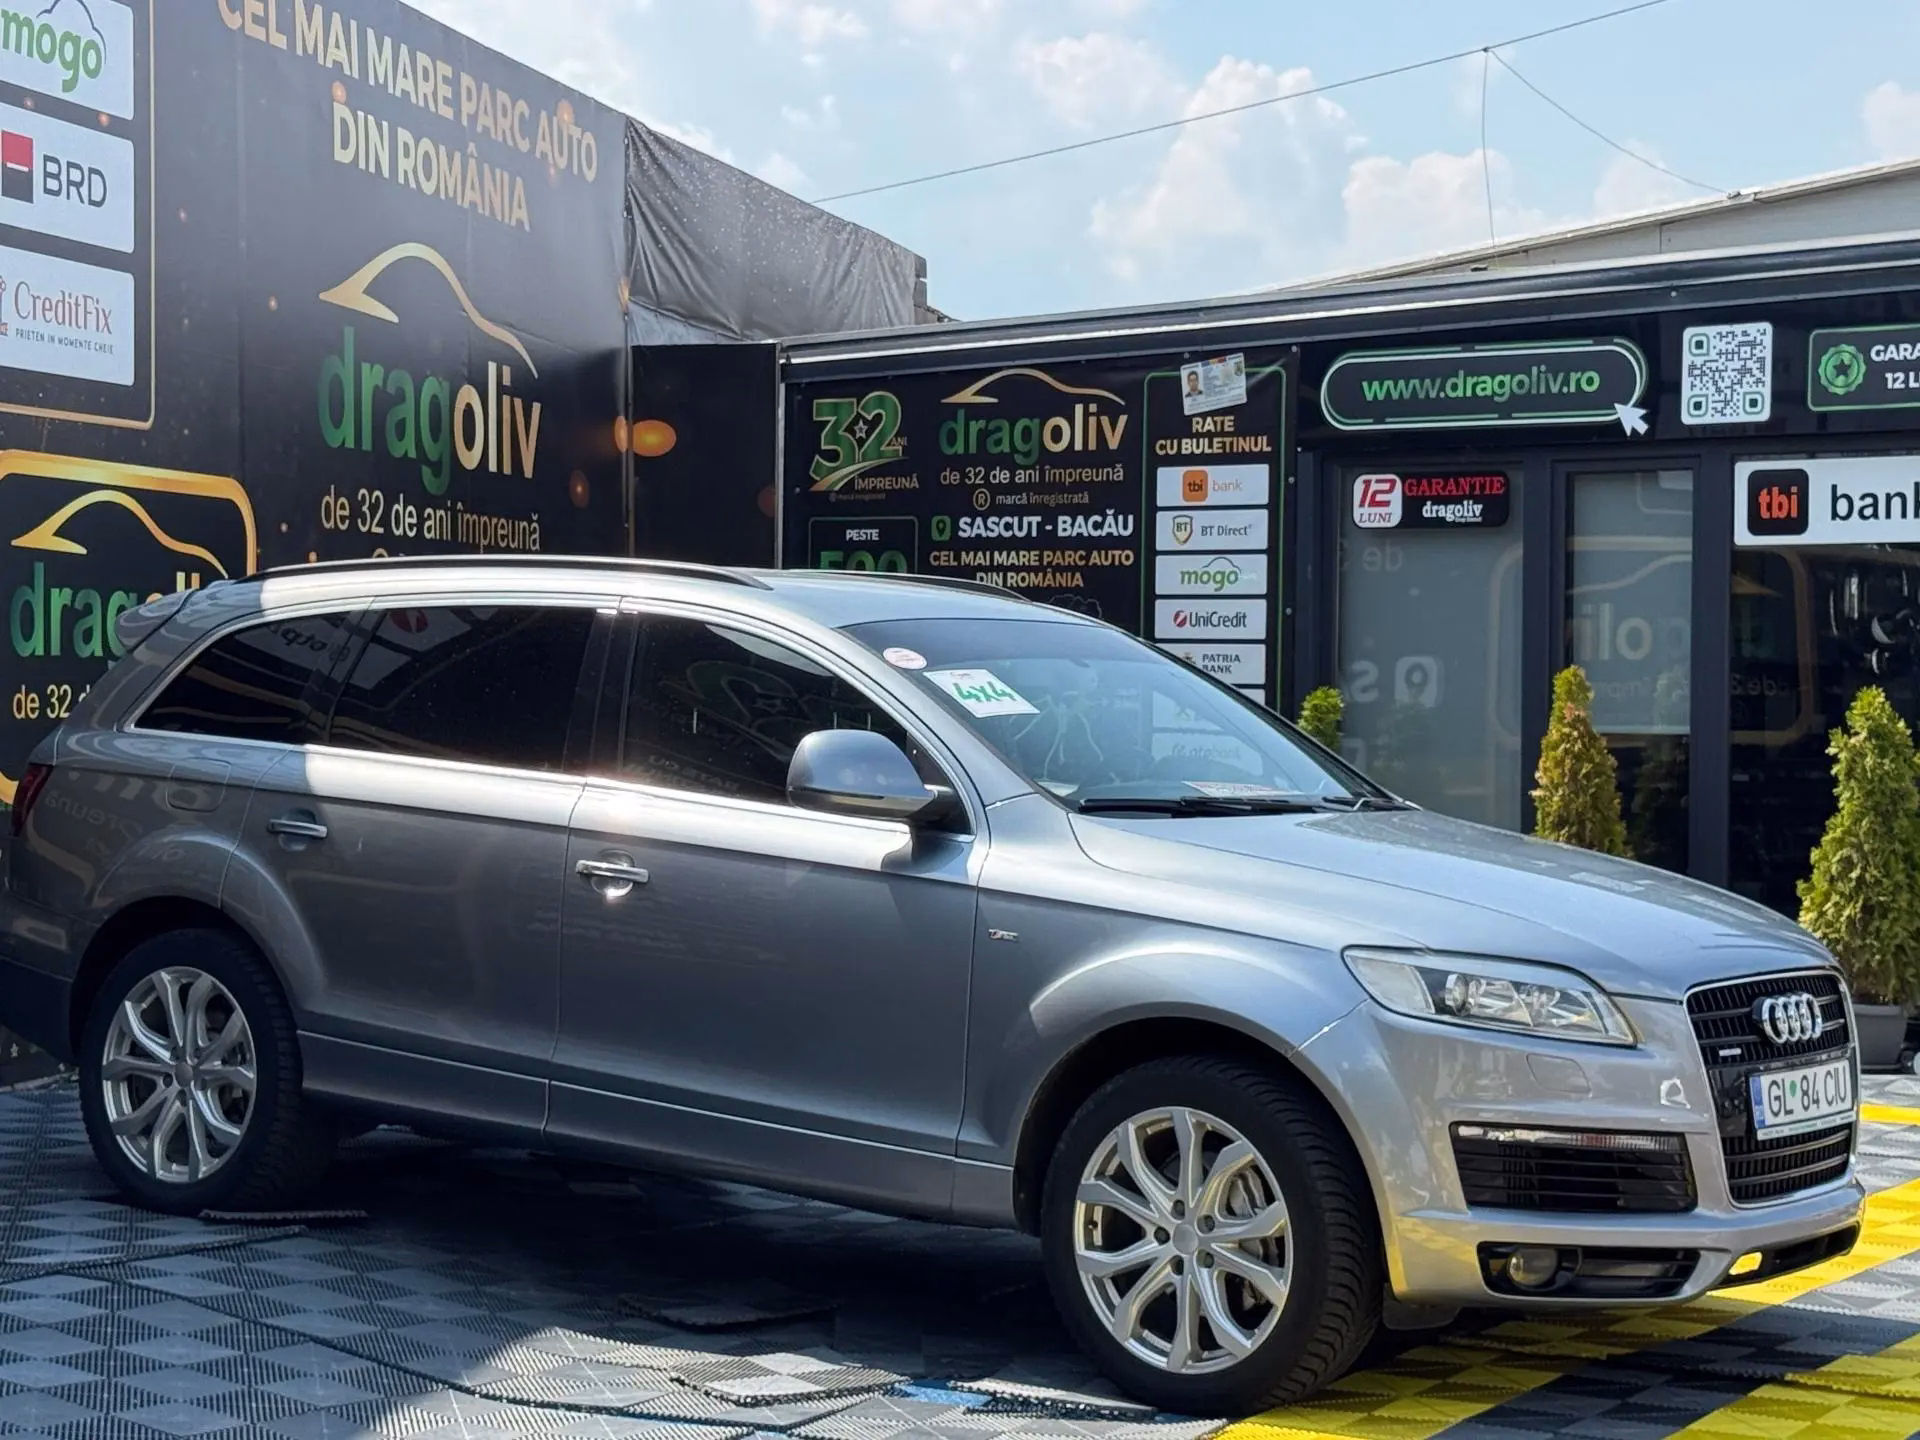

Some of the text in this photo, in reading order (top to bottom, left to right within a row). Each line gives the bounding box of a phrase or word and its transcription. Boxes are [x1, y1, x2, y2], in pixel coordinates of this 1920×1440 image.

[0, 8, 103, 93] mogo
[217, 0, 598, 183] CEL MAI MARE PARC AUTO
[333, 101, 531, 232] DIN ROMÂNIA
[42, 154, 107, 208] BRD
[14, 281, 113, 335] CreditFix
[15, 327, 45, 342] PRIETEN
[47, 333, 56, 344] IN
[57, 336, 92, 351] MOMENTE
[1361, 364, 1600, 403] www.dragoliv.ro
[1884, 372, 1906, 390] 12
[317, 325, 542, 496] dragoliv
[938, 403, 1129, 466] dragoliv
[1191, 415, 1235, 433] RATE
[809, 391, 902, 482] 32
[1155, 435, 1273, 456] CU BULETINUL
[940, 463, 1125, 486] de 32 de ani împreună
[1187, 478, 1243, 493] tbi bank
[995, 491, 1028, 505] marcă
[1358, 476, 1505, 509] 12 GARANTIE
[1757, 482, 1920, 522] tbi ban
[321, 484, 541, 554] de 32 de ani împreună
[957, 515, 1042, 538] SASCUT
[1056, 508, 1135, 537] BACĂU
[1358, 500, 1484, 524] LUNI dragoliv
[845, 528, 880, 541] PESTE
[1175, 521, 1189, 533] BT
[1200, 525, 1215, 537] BT
[929, 549, 1135, 567] CEL MAI MARE PARC AUTO
[975, 567, 1085, 588] DIN ROMÂNIA
[1179, 569, 1239, 593] mogo
[1189, 610, 1248, 629] UniCredit
[1202, 653, 1241, 664] PATRIA
[12, 684, 40, 719] de
[46, 683, 72, 719] 32
[1767, 1078, 1794, 1118] GL
[1800, 1069, 1821, 1113] 84
